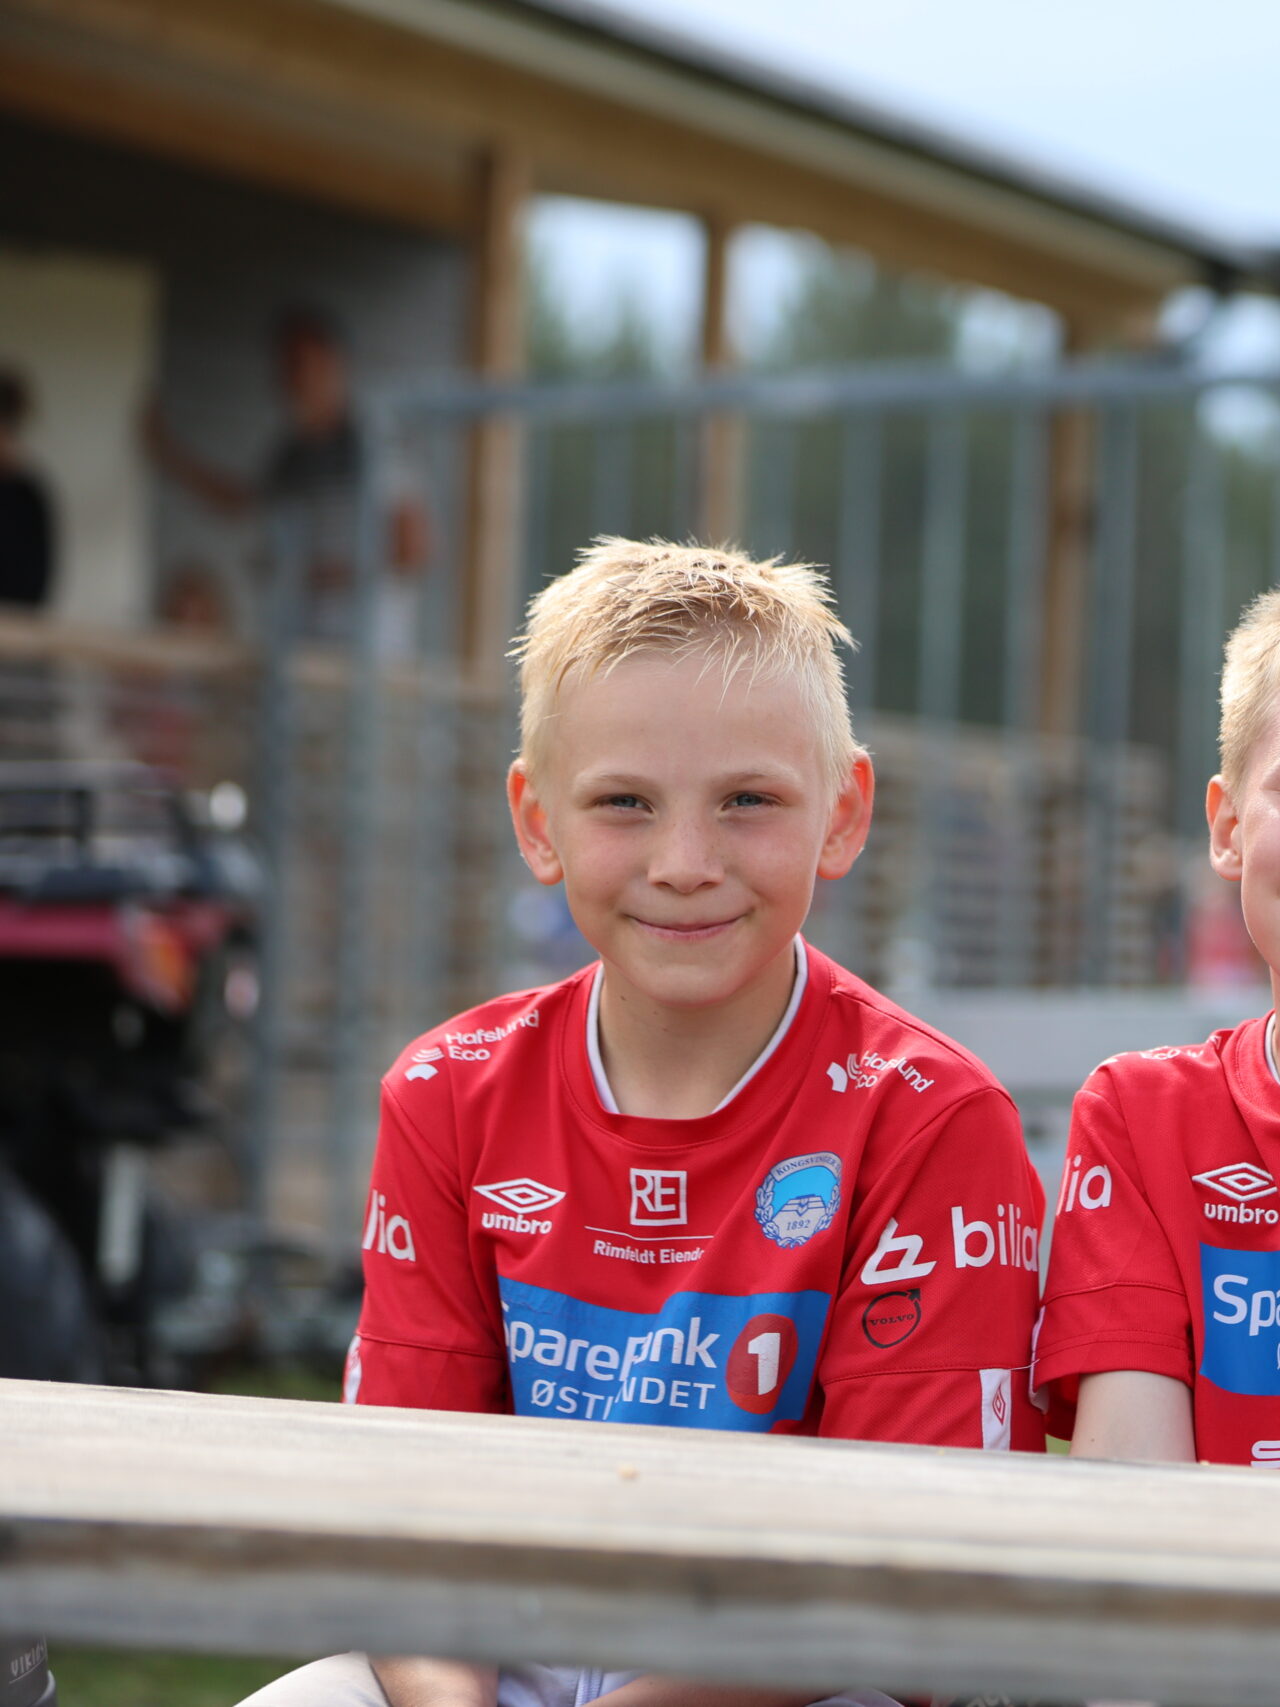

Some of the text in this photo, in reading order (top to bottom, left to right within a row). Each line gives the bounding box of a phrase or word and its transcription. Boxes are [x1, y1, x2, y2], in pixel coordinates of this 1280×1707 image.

[445, 1009, 540, 1045] Hafslund
[447, 1045, 491, 1062] Eco
[481, 1212, 553, 1235] umbro
[786, 1219, 811, 1231] 1892
[1204, 1203, 1280, 1225] umbro
[950, 1203, 1039, 1273] bilia
[593, 1239, 657, 1264] Rimfeldt
[869, 1313, 915, 1326] VOLVO
[748, 1332, 781, 1396] 1
